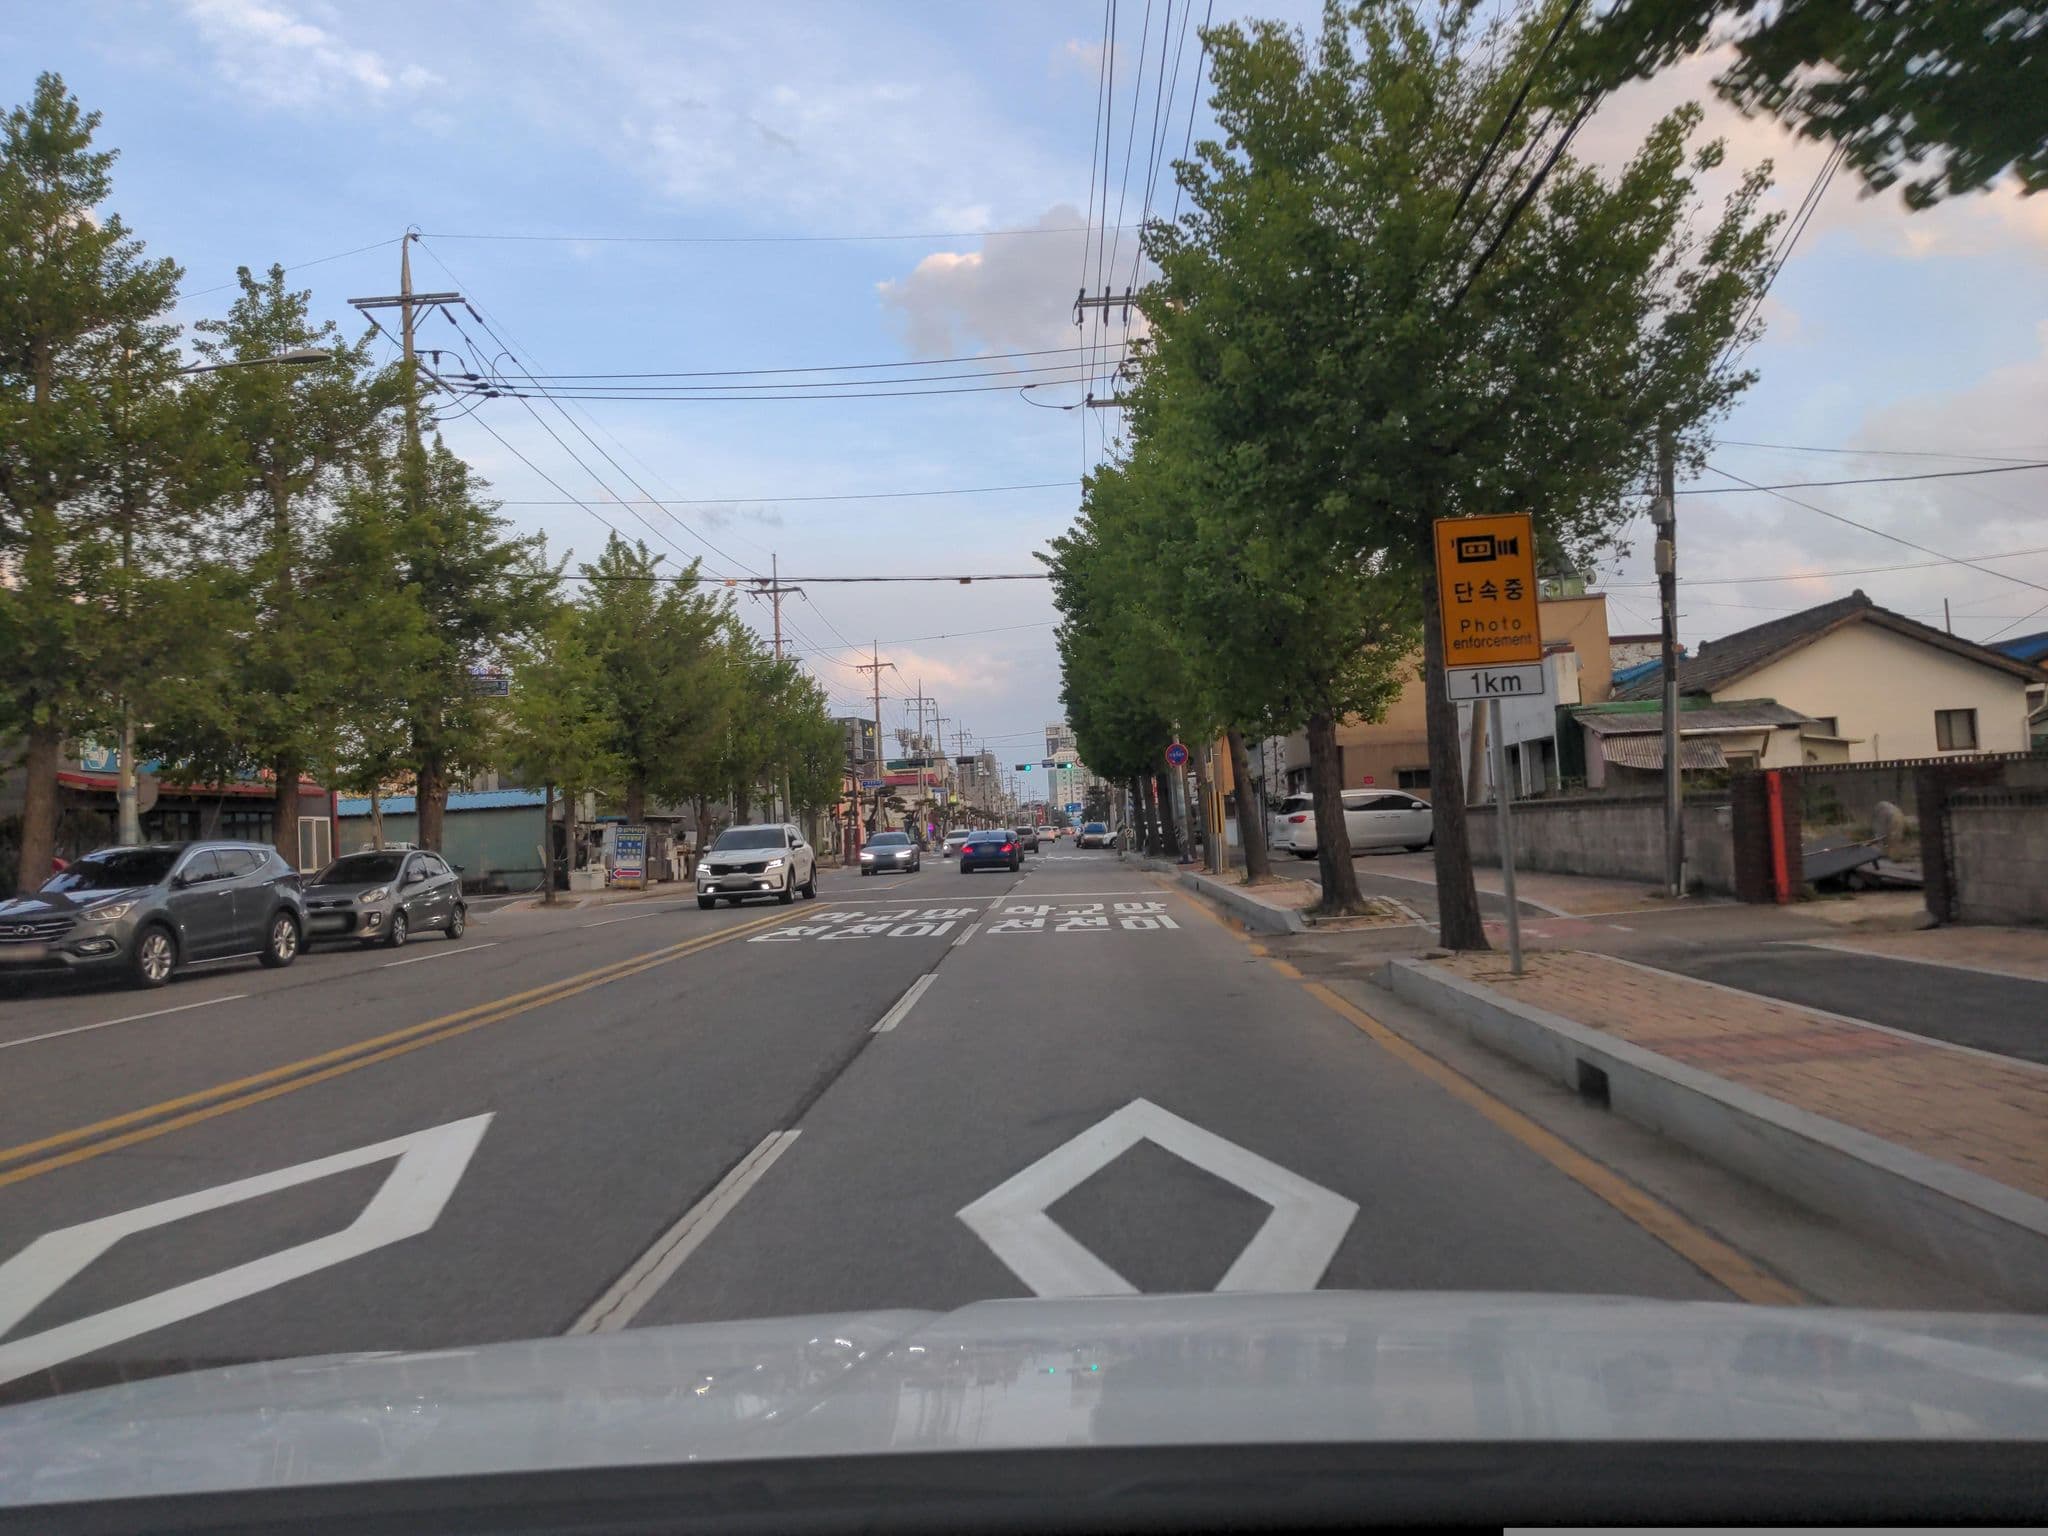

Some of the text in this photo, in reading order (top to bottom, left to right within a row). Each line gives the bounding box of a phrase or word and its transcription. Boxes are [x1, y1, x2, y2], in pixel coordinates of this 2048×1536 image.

[1455, 579, 1524, 604] 단속중
[1460, 617, 1522, 633] Photo
[1453, 633, 1532, 650] enforcement
[1471, 671, 1521, 694] 1km
[746, 920, 957, 942] 천천히
[986, 914, 1181, 934] 천천히
